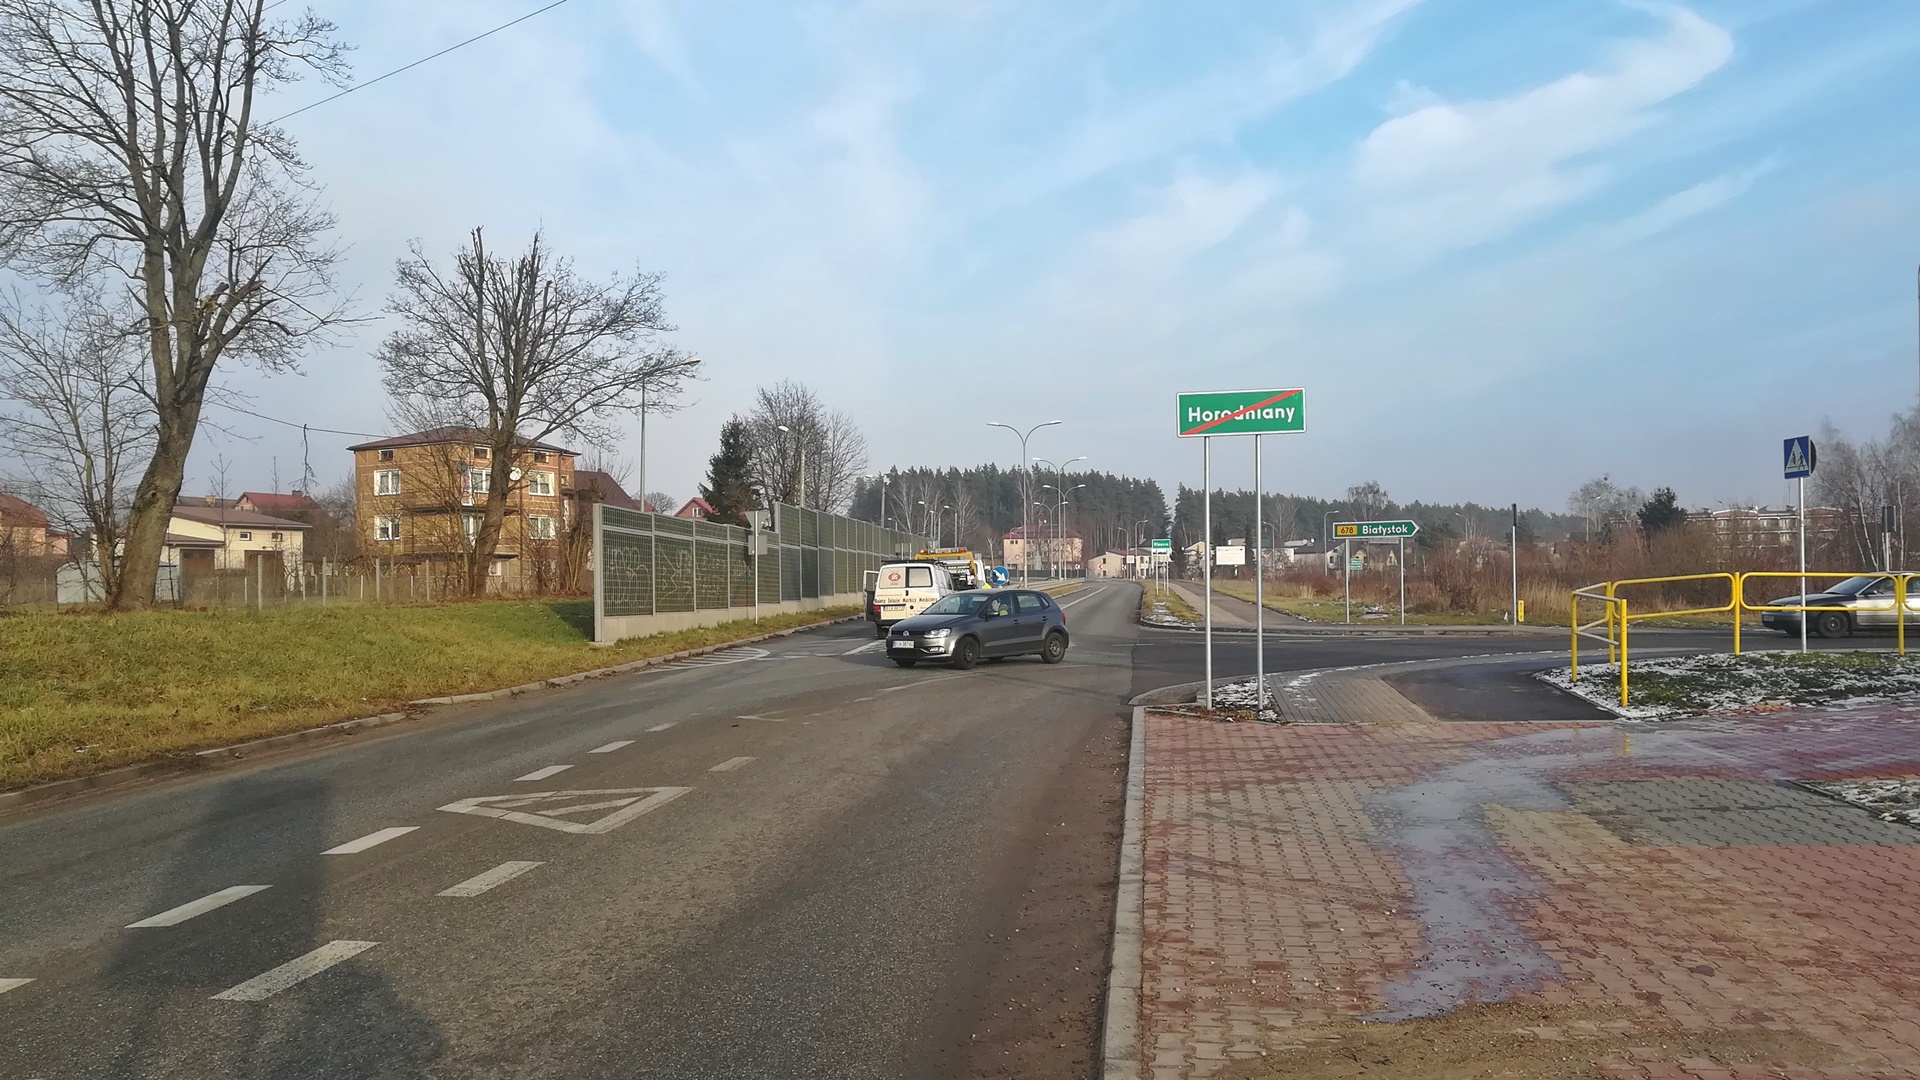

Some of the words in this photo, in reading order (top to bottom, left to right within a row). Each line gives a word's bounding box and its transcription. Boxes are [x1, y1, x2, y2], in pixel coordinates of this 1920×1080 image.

[1188, 405, 1295, 422] Horodniany
[1340, 526, 1354, 534] 678
[1362, 524, 1408, 536] Białystok
